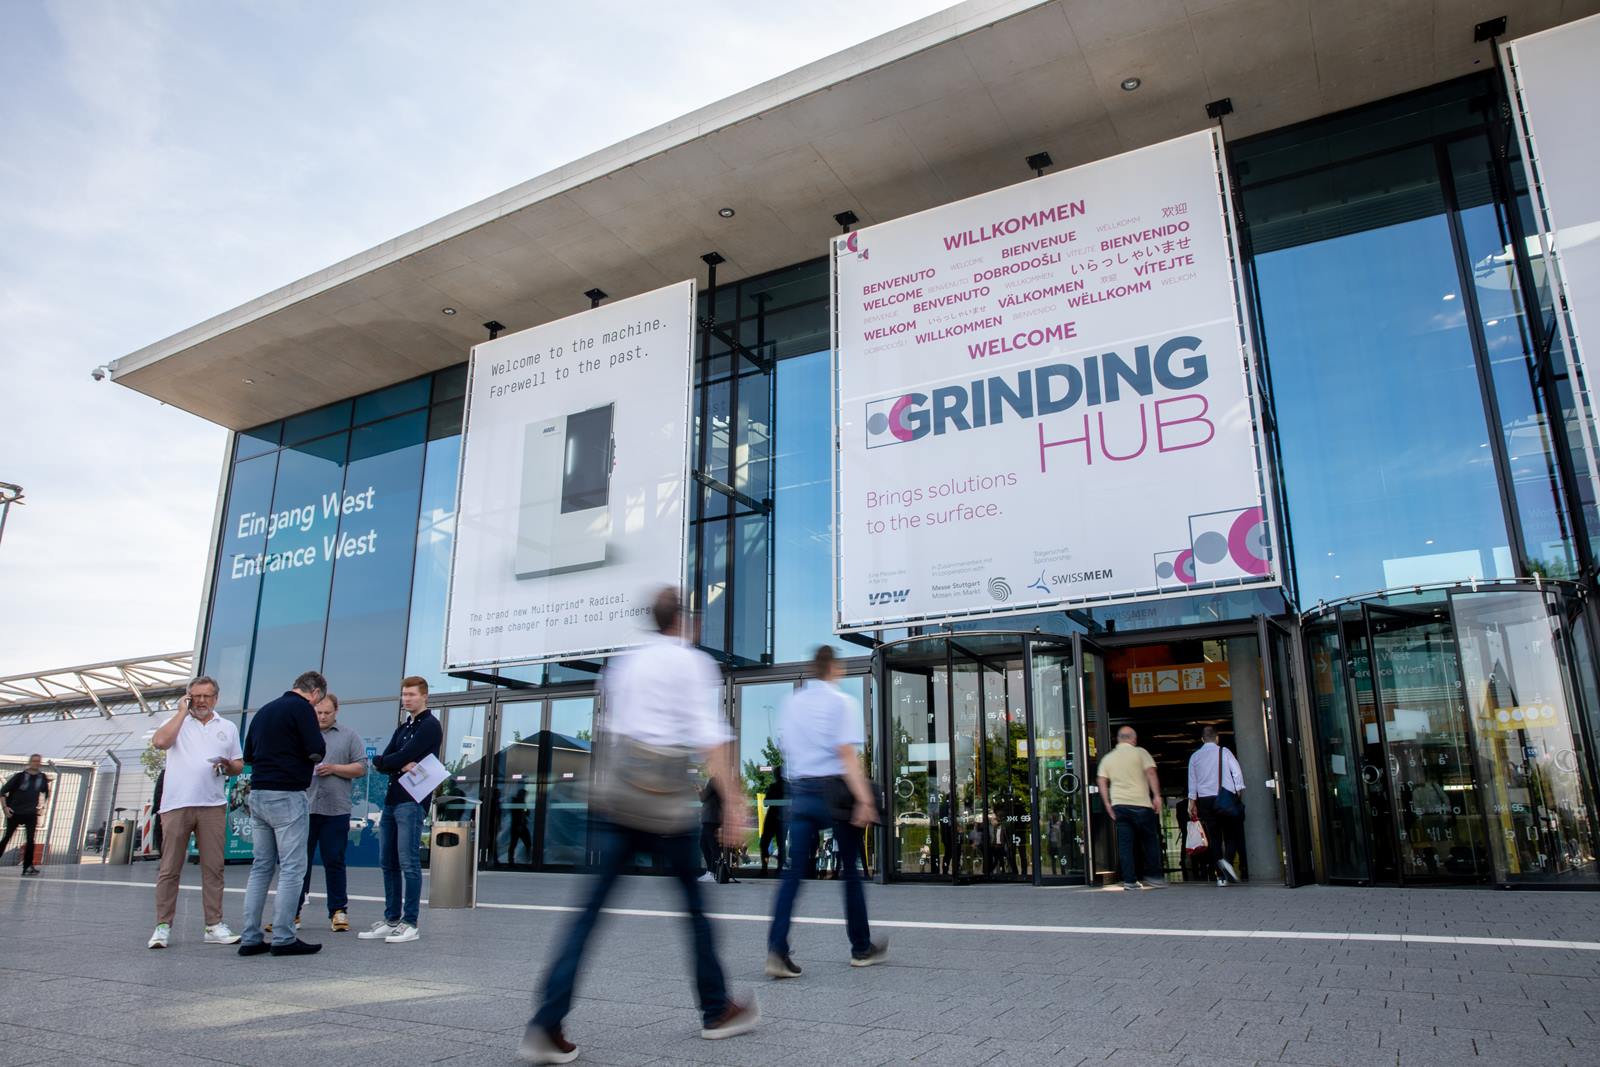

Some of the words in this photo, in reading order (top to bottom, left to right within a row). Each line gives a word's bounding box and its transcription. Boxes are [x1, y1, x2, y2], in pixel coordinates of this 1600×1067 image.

[943, 200, 1086, 251] WILLKOMMEN
[1161, 202, 1188, 219] 欢迎
[1001, 231, 1077, 259] BIENVENUE
[1071, 237, 1192, 276] いらっしゃいませ
[863, 288, 924, 312] WELCOME
[973, 252, 1062, 283] DOBRODOŠLI
[1100, 220, 1190, 252] BIENVENIDO
[863, 268, 936, 296] BENVENUTO
[1134, 253, 1195, 277] VÍTEJTE
[913, 286, 991, 314] BENVENUTO
[998, 279, 1085, 309] VÄLKOMMEN
[915, 315, 1003, 345] WILLKOMMEN
[1067, 280, 1152, 309] WËLLKOMM
[491, 353, 541, 377] Welcome
[549, 346, 563, 359] to
[571, 337, 594, 353] the
[602, 319, 667, 345] machine.
[863, 320, 917, 342] WELKOM
[967, 321, 1078, 360] WELCOME
[490, 372, 546, 399] Farewell
[555, 367, 570, 381] to
[578, 358, 601, 374] the
[610, 345, 648, 368] past.
[889, 335, 1209, 443] GRINDING
[1038, 393, 1216, 473] HUB
[866, 486, 923, 509] Brings
[928, 471, 1018, 497] solutions
[237, 504, 316, 539] Eingang
[322, 486, 376, 519] West
[866, 519, 886, 535] to
[890, 511, 922, 533] the
[926, 500, 1003, 527] surface.
[231, 546, 316, 580] Entrance
[323, 529, 377, 561] West
[931, 583, 951, 592] Messe
[952, 580, 981, 590] Stuttgart
[1051, 568, 1113, 585] SWISSMEM
[470, 613, 483, 622] The
[487, 609, 509, 621] brand
[513, 608, 527, 617] new
[589, 593, 630, 607] Radical.
[868, 589, 911, 606] VDW
[469, 627, 482, 637] The
[485, 625, 503, 635] game
[507, 621, 540, 633] changer
[545, 617, 560, 628] for
[563, 614, 578, 625] all
[584, 612, 603, 623] tool
